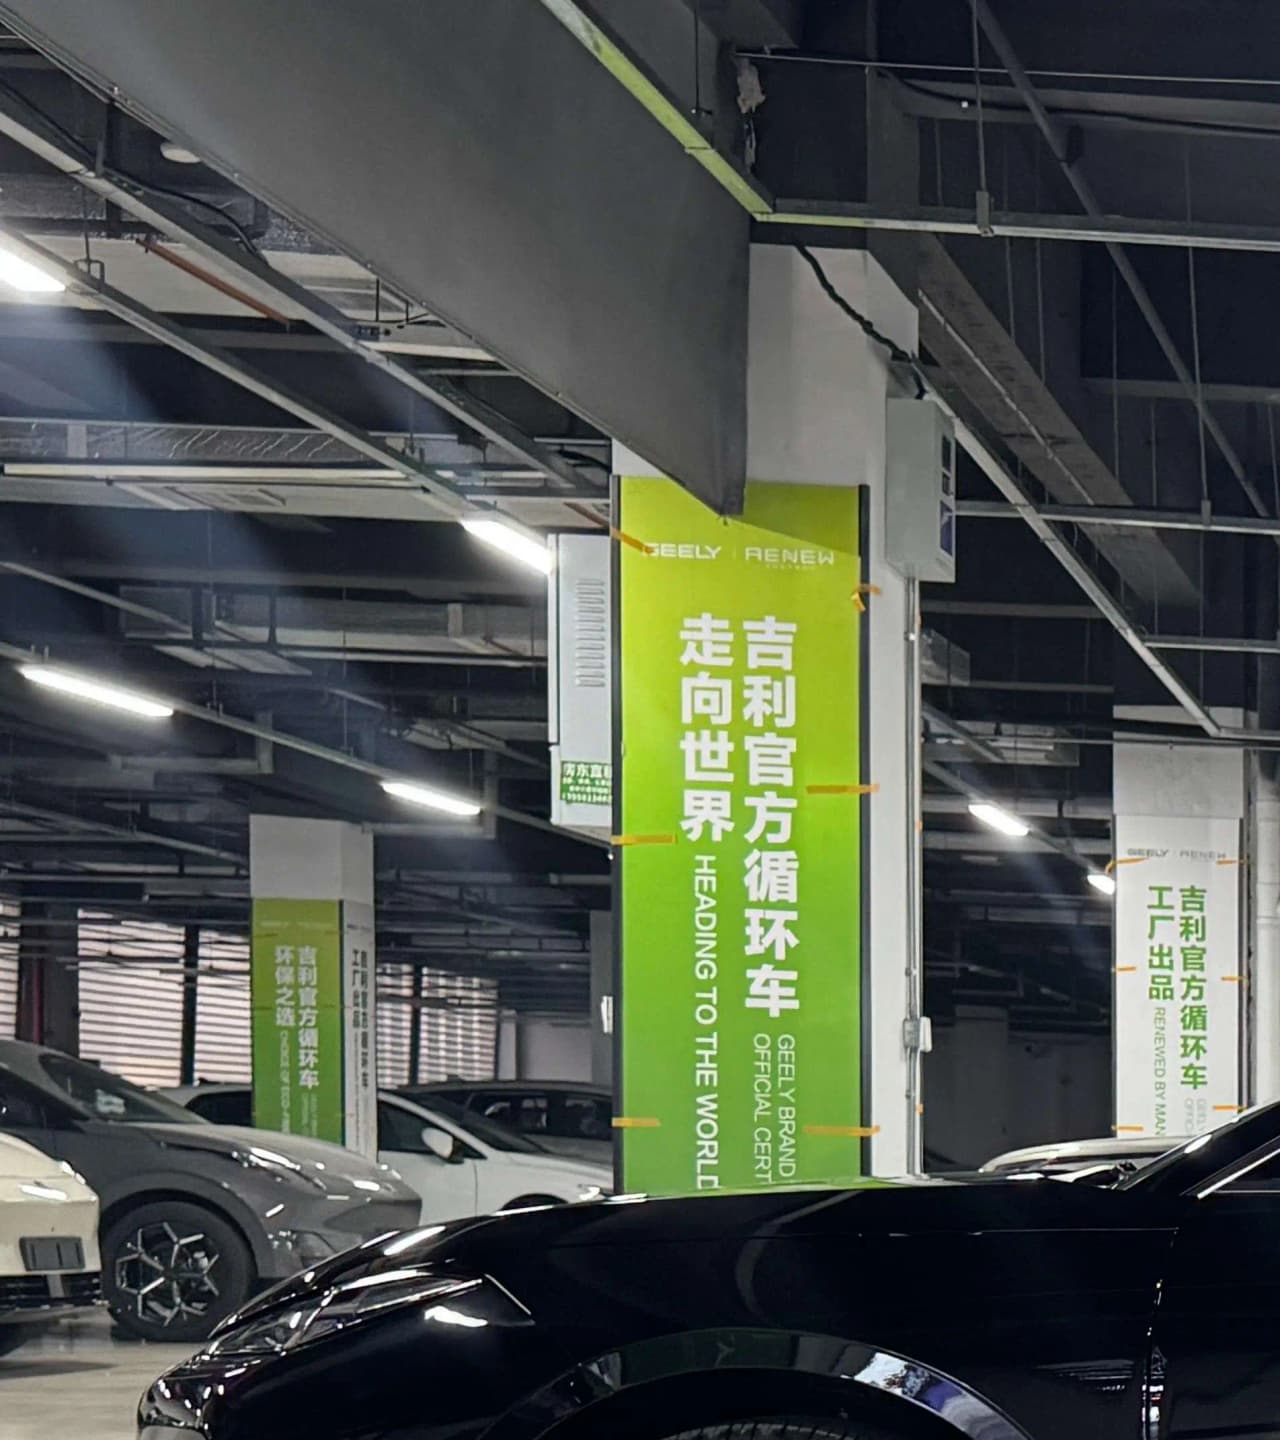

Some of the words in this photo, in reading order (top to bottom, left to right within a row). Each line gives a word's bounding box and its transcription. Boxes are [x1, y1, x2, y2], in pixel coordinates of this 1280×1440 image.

[680, 612, 735, 842] 走向世界
[743, 615, 800, 1018] 吉利官方循环车
[694, 854, 717, 980] HEADING
[1147, 885, 1175, 1001] 工厂出品
[695, 986, 718, 1025] TO
[1179, 884, 1208, 1090] 吉利官方循环车
[695, 1031, 718, 1087] THE
[753, 1033, 772, 1123] OFFICIAL
[778, 1033, 796, 1103] GEELY
[1154, 1007, 1166, 1078] RENEWED
[1154, 1081, 1167, 1100] BY
[778, 1106, 796, 1178] BRAND
